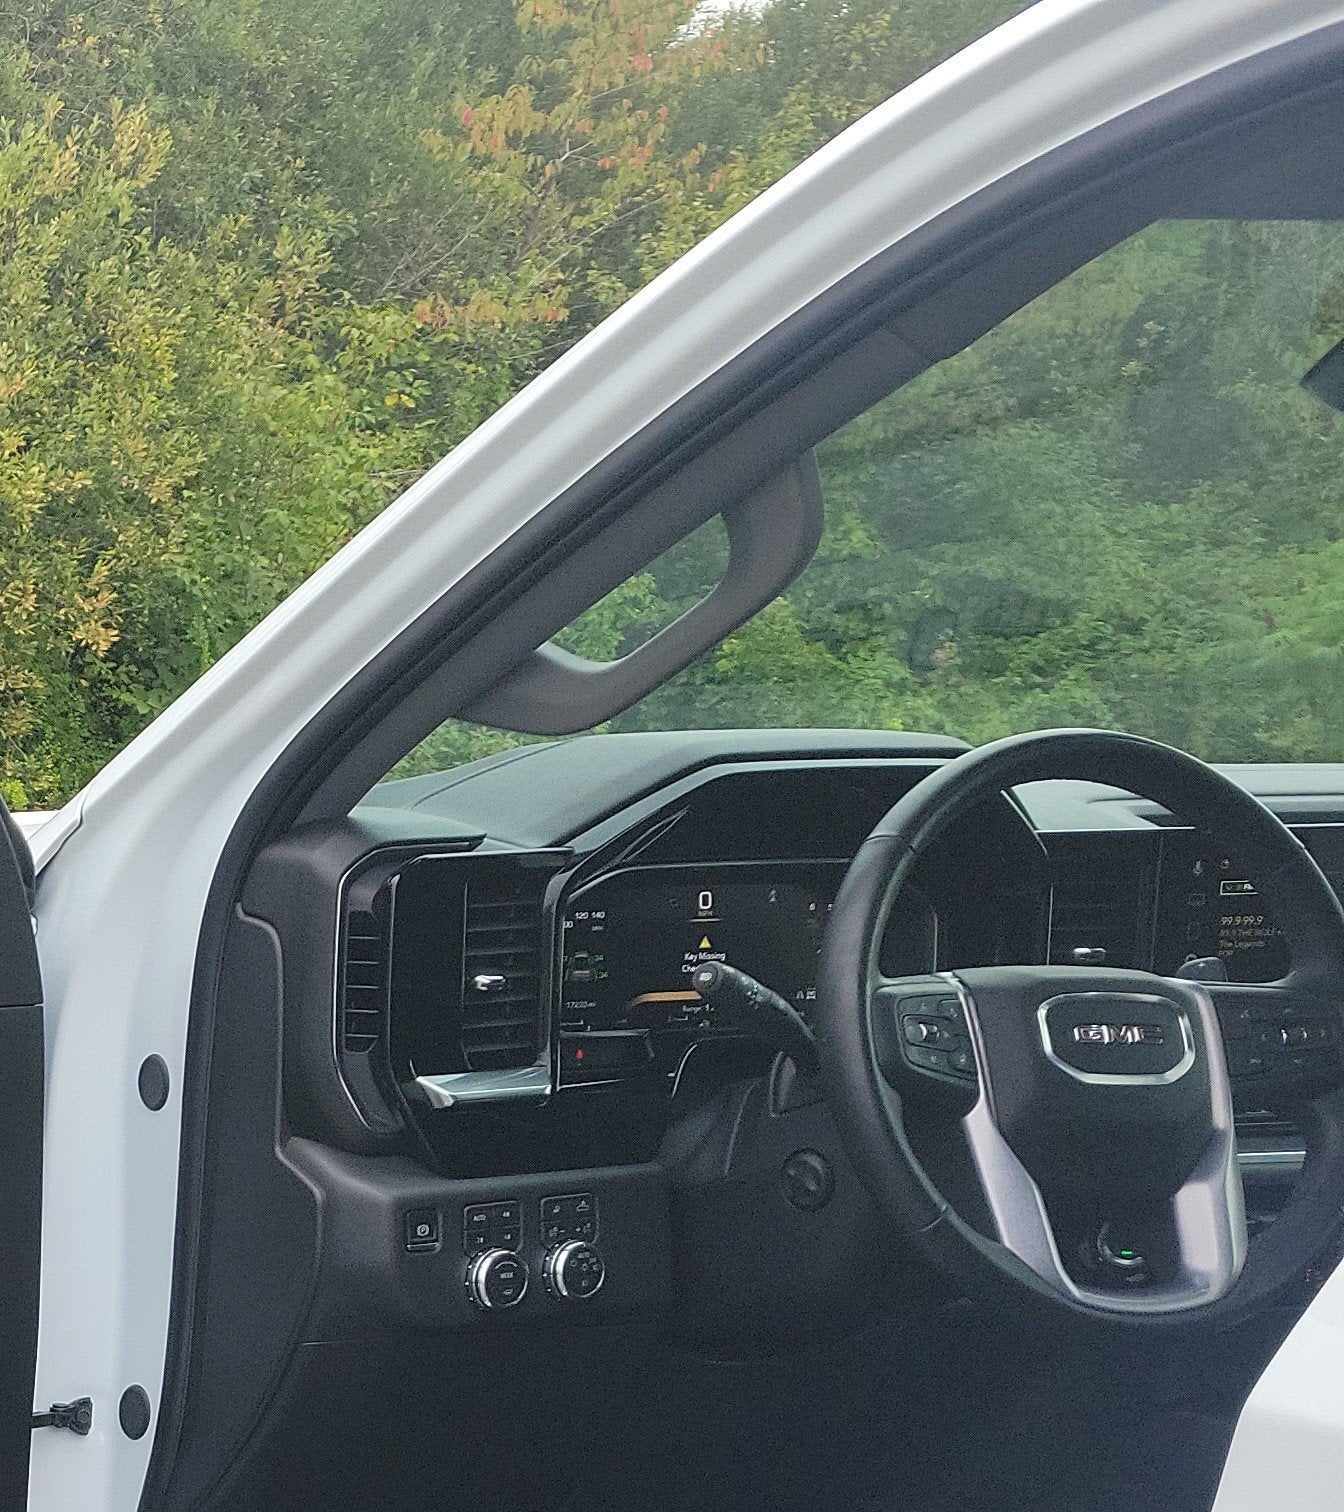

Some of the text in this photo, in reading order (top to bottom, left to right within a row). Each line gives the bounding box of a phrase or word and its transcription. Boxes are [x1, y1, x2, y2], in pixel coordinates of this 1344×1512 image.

[698, 890, 713, 910] 0
[575, 911, 606, 920] 120 140
[684, 951, 726, 962] Key Missing
[1072, 1024, 1164, 1045] GMC
